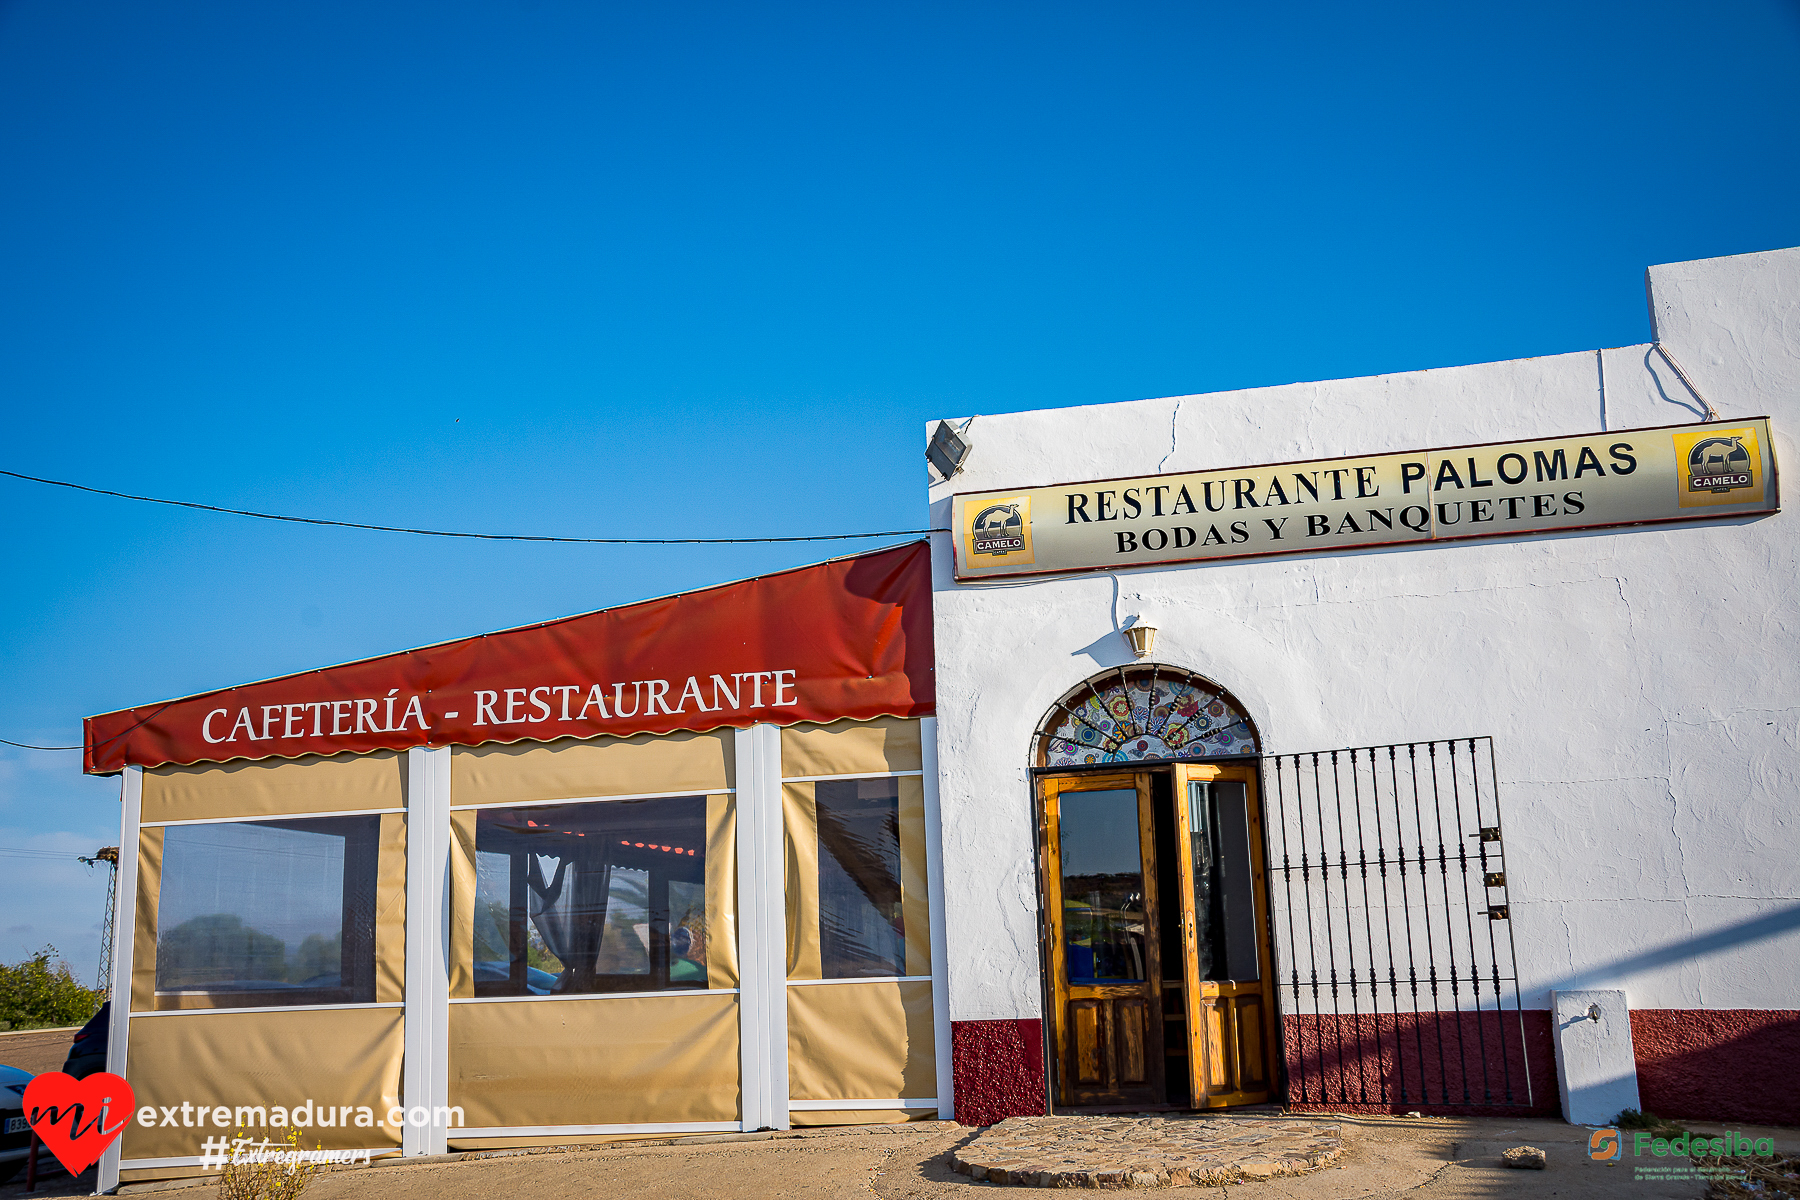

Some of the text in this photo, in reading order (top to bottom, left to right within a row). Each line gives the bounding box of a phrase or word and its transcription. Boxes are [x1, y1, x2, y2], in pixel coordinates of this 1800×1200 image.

[1065, 442, 1638, 525] RESTAURANTE PALOMAS
[1693, 475, 1747, 486] CAMELO
[977, 539, 1021, 550] CAMELO
[1115, 490, 1585, 554] BODAS Y BANQUETES
[202, 688, 432, 745] CAFETERÍA
[472, 669, 799, 726] RESTAURANTE
